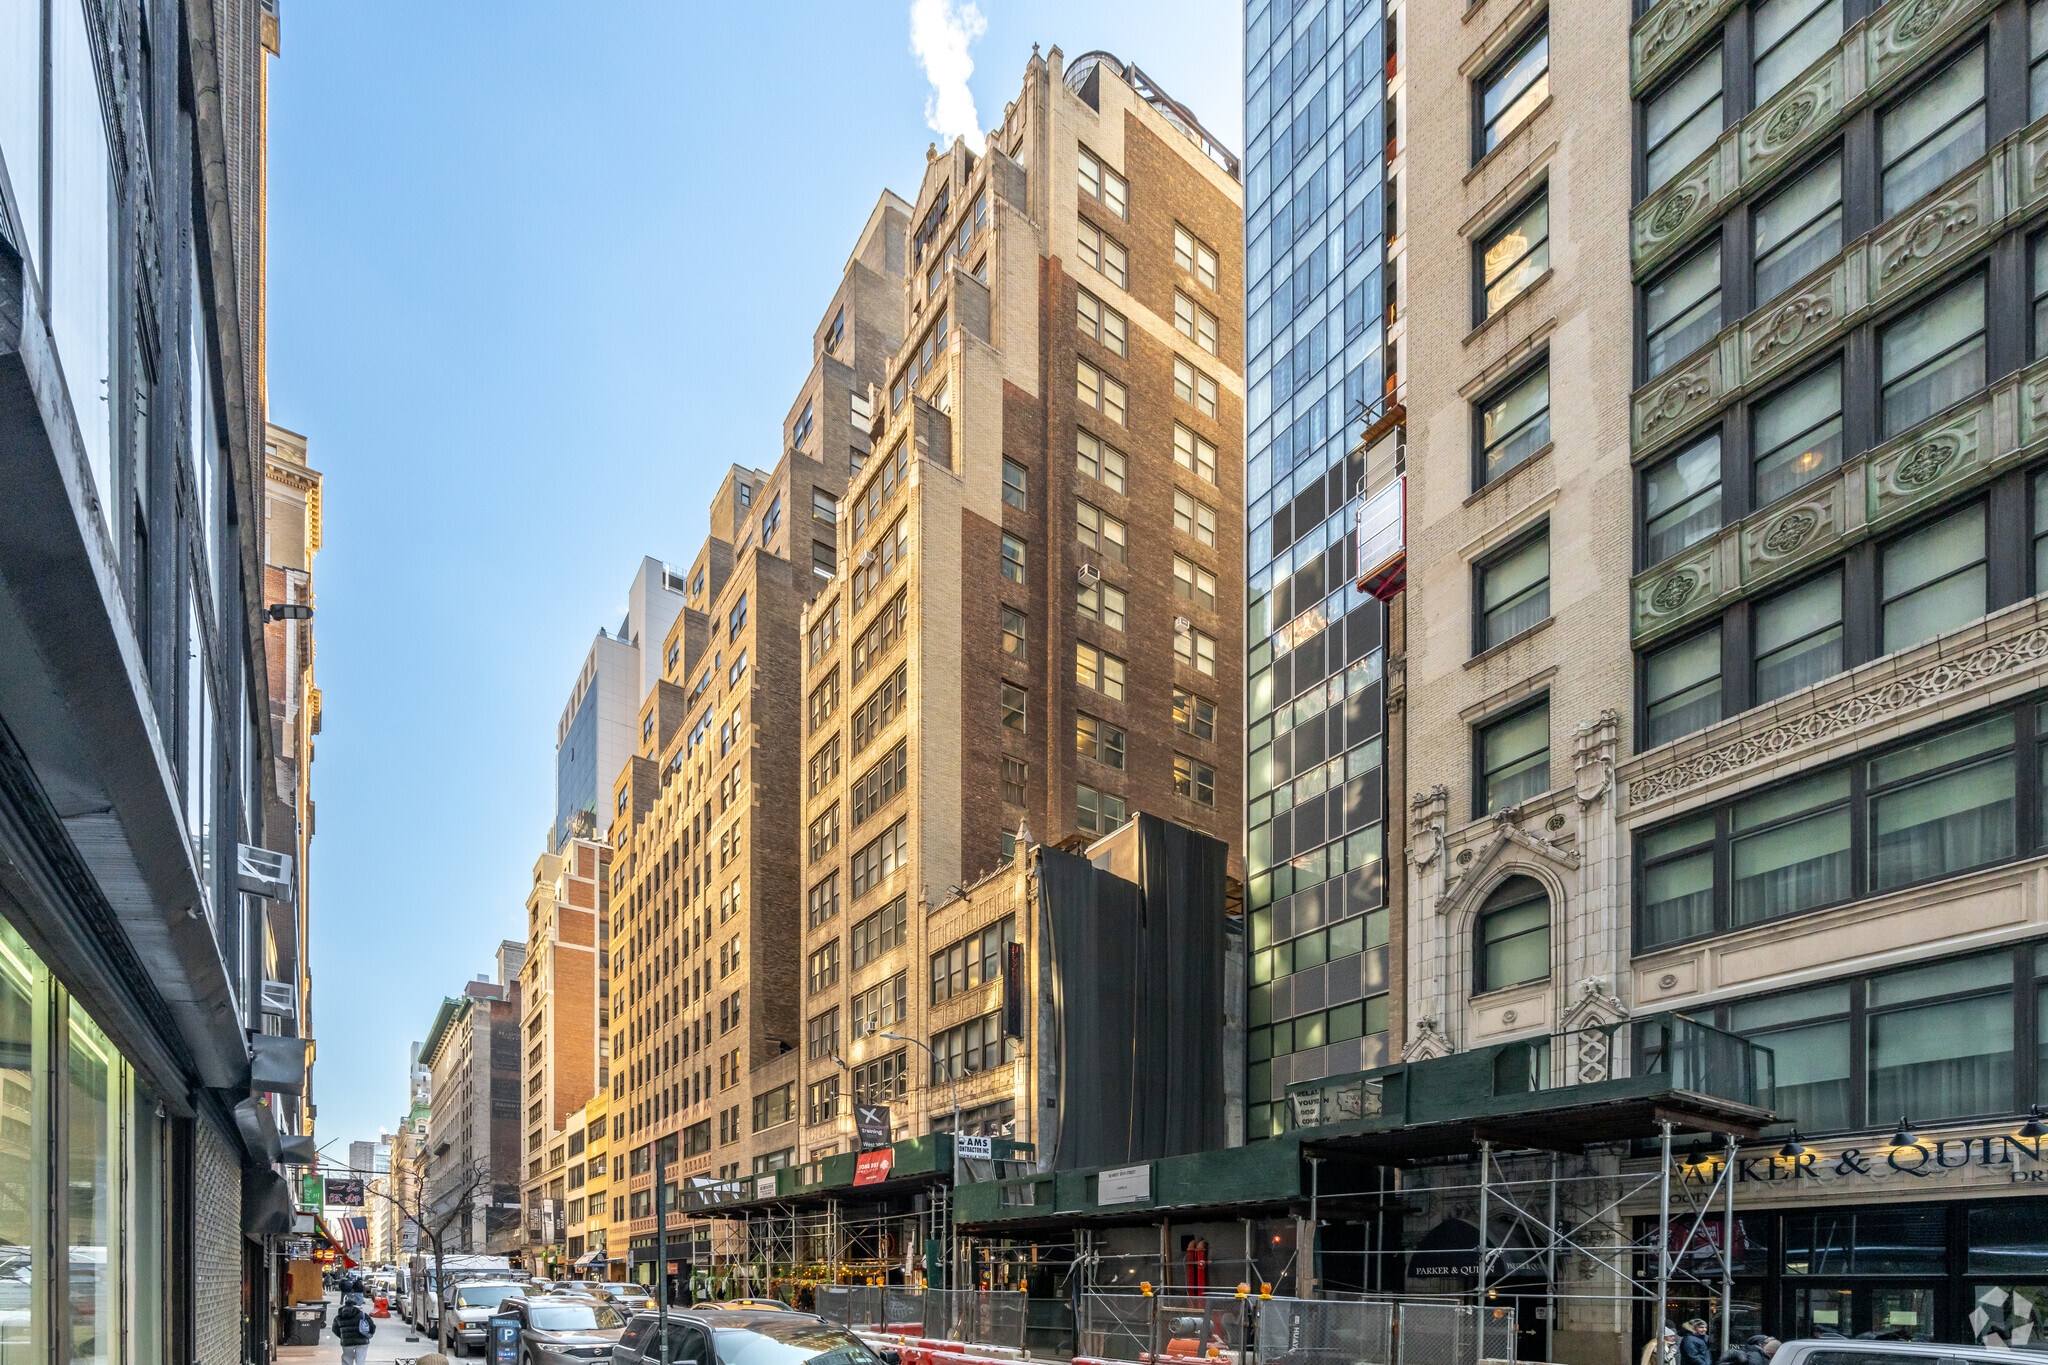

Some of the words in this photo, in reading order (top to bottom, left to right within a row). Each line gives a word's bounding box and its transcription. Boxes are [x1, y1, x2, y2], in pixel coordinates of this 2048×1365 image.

[967, 1138, 988, 1147] AMS
[959, 1145, 982, 1154] ONTRACTOR
[1834, 1148, 1871, 1176] &
[2010, 1169, 2048, 1183] DR
[1668, 1192, 1709, 1205] OOD
[1416, 1266, 1449, 1275] PARKER
[1451, 1266, 1459, 1274] &
[1460, 1265, 1495, 1276] QUIN
[504, 1329, 514, 1341] P
